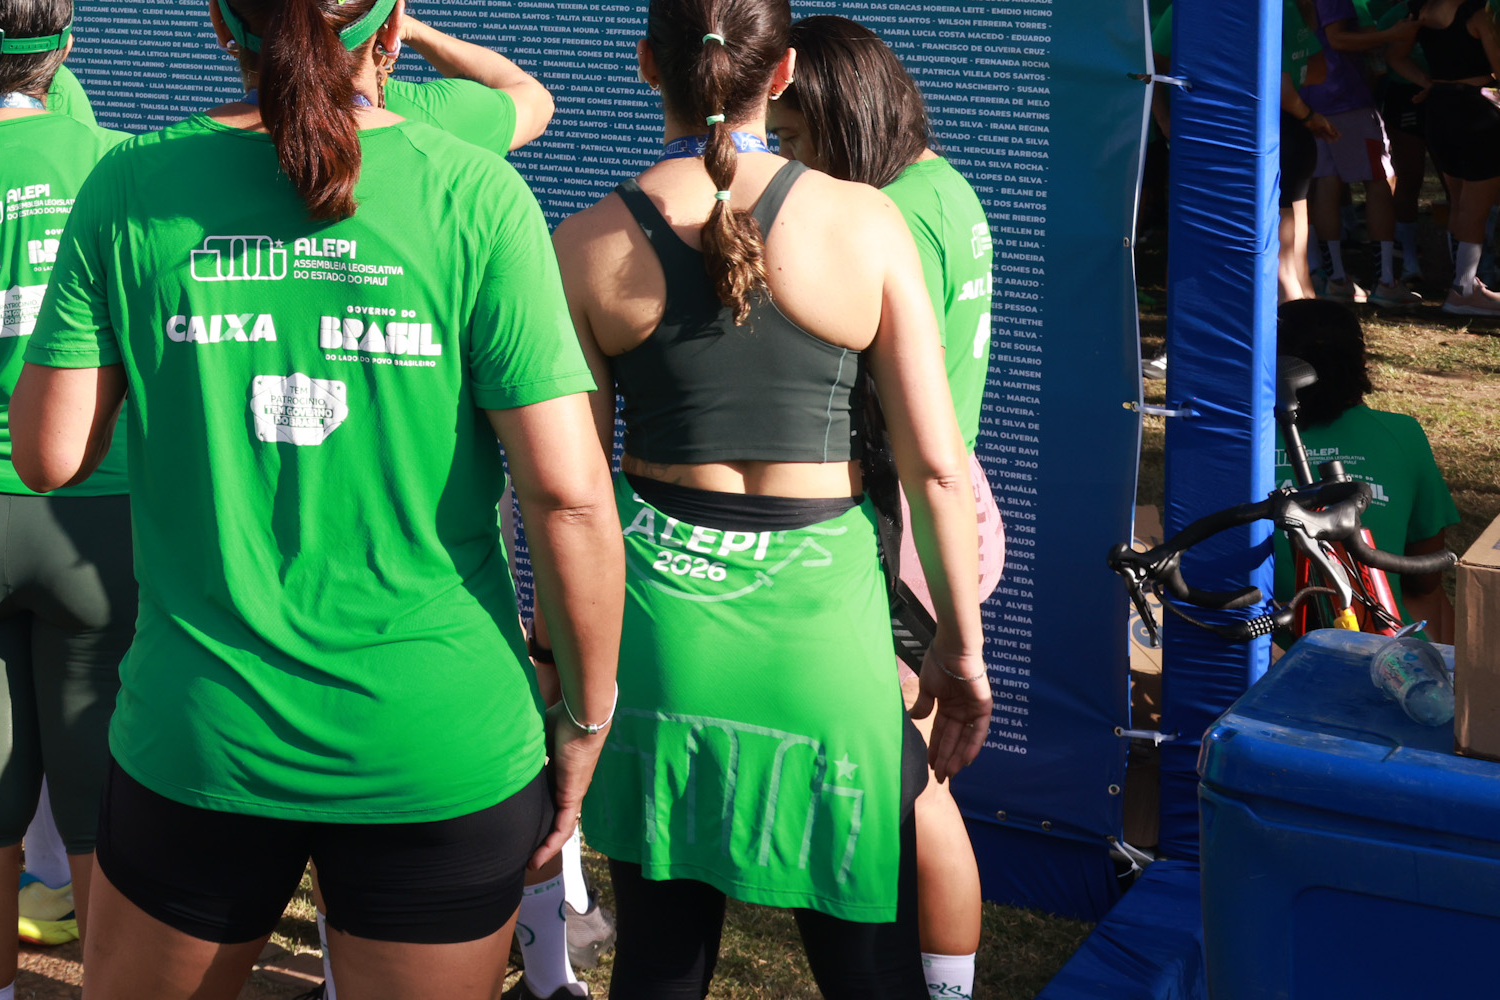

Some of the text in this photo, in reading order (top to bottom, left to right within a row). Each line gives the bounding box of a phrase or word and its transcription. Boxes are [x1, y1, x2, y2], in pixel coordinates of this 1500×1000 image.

[6, 183, 50, 203] ALEPI
[6, 200, 44, 212] ASSEMBLEIA
[1013, 201, 1046, 210] SANTOS
[7, 212, 18, 220] DO
[19, 207, 44, 218] ESTADO
[1012, 214, 1046, 223] RIBEIRO
[1000, 226, 1032, 234] HELLEN
[294, 237, 357, 259] ALEPI
[1019, 240, 1039, 248] LIMA
[1001, 252, 1044, 261] BANDEIRA
[293, 259, 404, 275] ASSEMBLEIA LEGISLATIVA
[1000, 264, 1030, 273] GOMES
[293, 270, 388, 286] DO ESTADO DO PIAUÍ
[1004, 278, 1039, 287] ARAUJO
[1004, 290, 1038, 300] FRAZAO
[346, 305, 416, 318] GOVERNO DO
[1004, 303, 1037, 312] PESSOA
[166, 313, 277, 344] CAIXA
[320, 315, 442, 356] BRASIL
[325, 353, 436, 367] DO LADO DO POVO BRASILEIRO
[289, 385, 308, 395] TEM
[622, 506, 771, 561] ALEPI
[652, 551, 727, 582] 2026
[1003, 613, 1032, 624] MARIA
[997, 625, 1032, 637] SANTOS
[993, 637, 1017, 647] TEIVE
[992, 651, 1031, 662] LUCIANO
[1002, 679, 1029, 689] BRITO
[990, 714, 1009, 724] REIS
[998, 730, 1027, 741] MARIA
